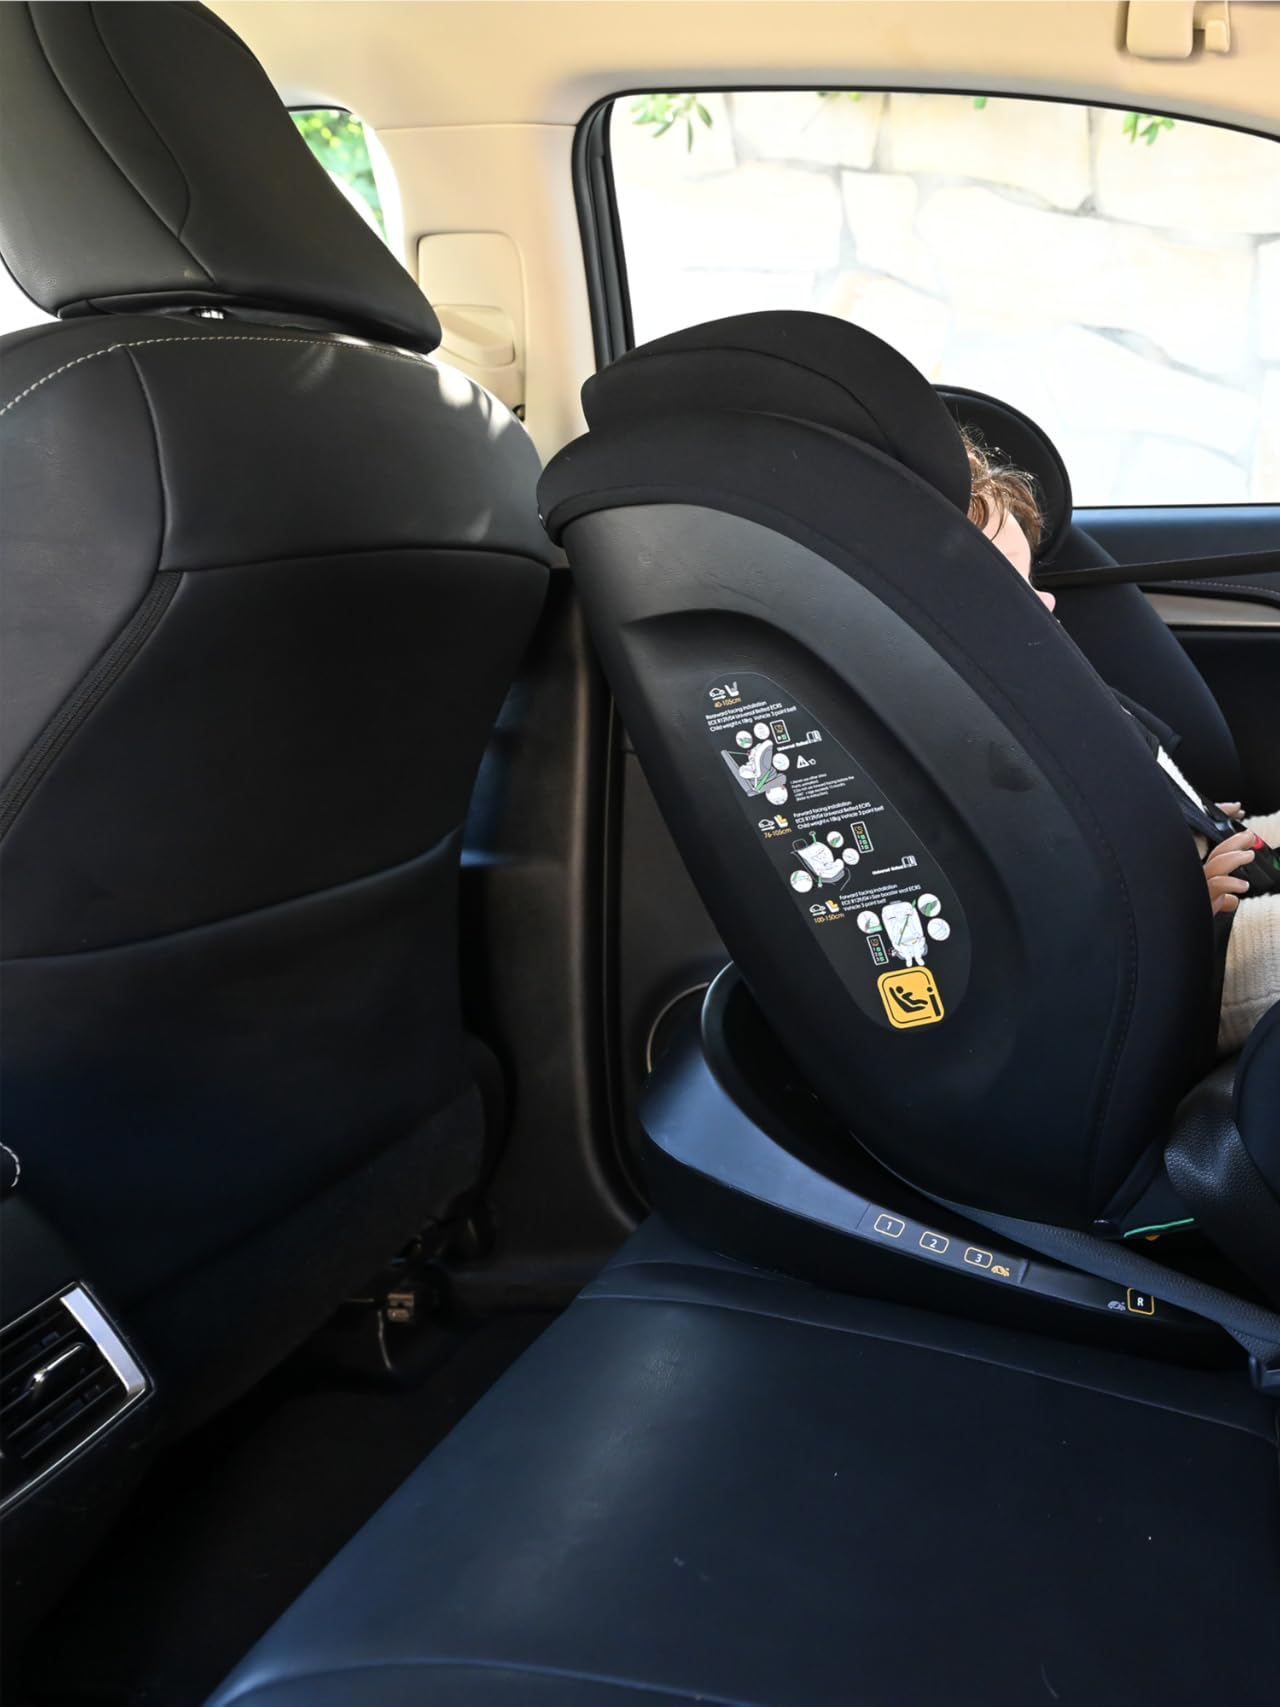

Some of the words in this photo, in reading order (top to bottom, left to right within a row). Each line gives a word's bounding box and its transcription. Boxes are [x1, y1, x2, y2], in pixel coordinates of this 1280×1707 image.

[743, 701, 767, 710] installation
[753, 713, 770, 721] Vehicle
[793, 810, 812, 818] Forward
[812, 806, 827, 814] facing
[828, 801, 852, 809] installation
[764, 828, 792, 838] 76-105cm
[873, 884, 898, 892] installation
[814, 913, 845, 924] 100-150cm
[886, 1221, 892, 1230] 1
[930, 1239, 938, 1248] 2
[974, 1253, 983, 1263] 3
[1137, 1297, 1144, 1307] R
